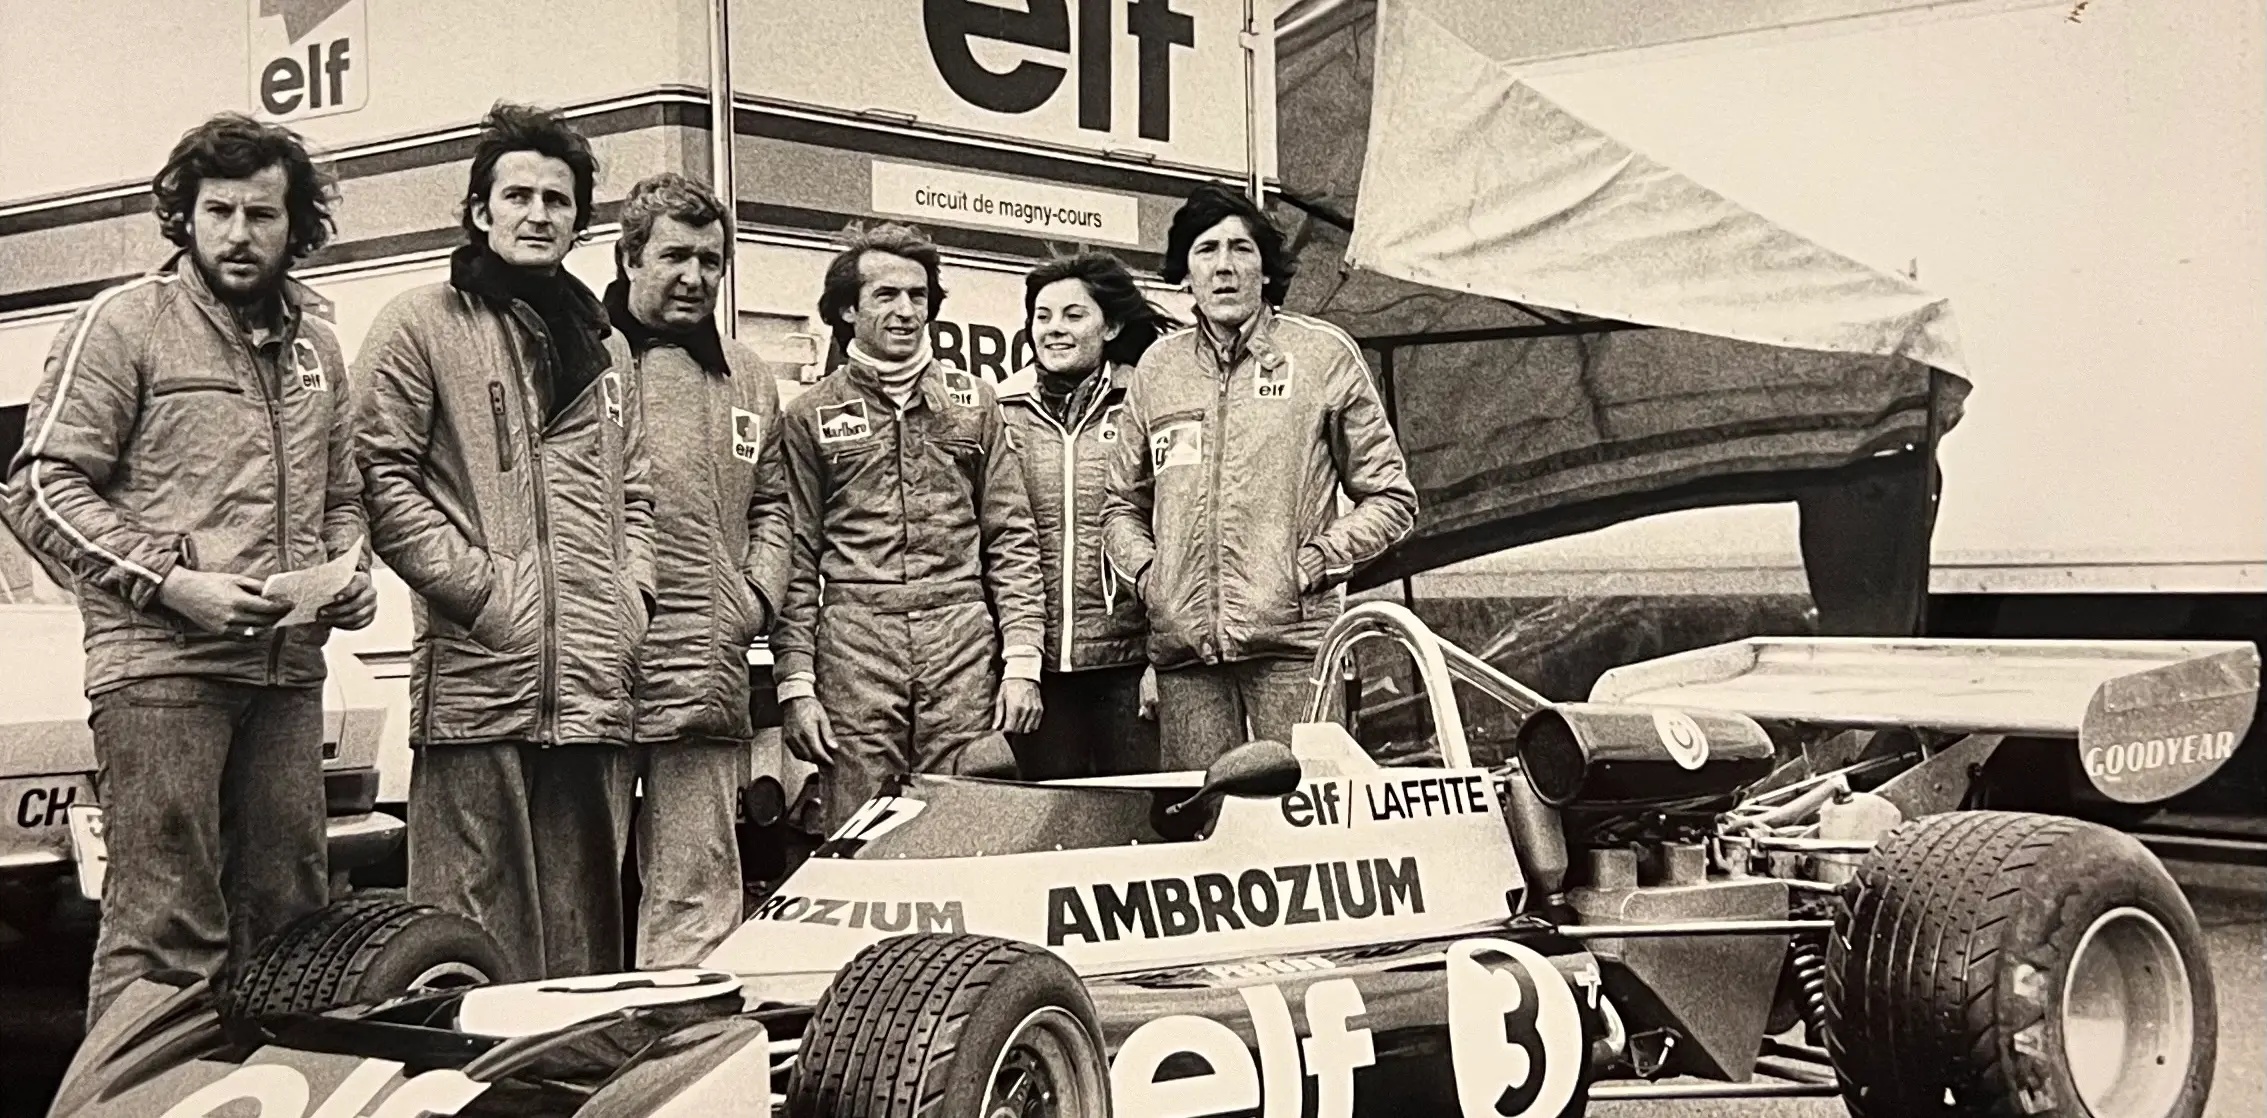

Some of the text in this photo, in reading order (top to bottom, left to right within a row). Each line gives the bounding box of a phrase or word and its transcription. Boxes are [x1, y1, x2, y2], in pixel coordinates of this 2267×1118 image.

[260, 37, 350, 116] elf
[922, 0, 1194, 142] elf
[915, 186, 1102, 228] circuit de magny-cours
[303, 374, 321, 388] elf
[1259, 384, 1285, 397] elf
[736, 443, 755, 459] elf
[2084, 731, 2236, 778] GOODYEAR
[1281, 781, 1341, 828] elf
[1366, 775, 1489, 821] LAFFITE
[1046, 856, 1426, 947] AMBROZIUM
[1109, 977, 1376, 1118] elf
[1470, 948, 1547, 1118] 3
